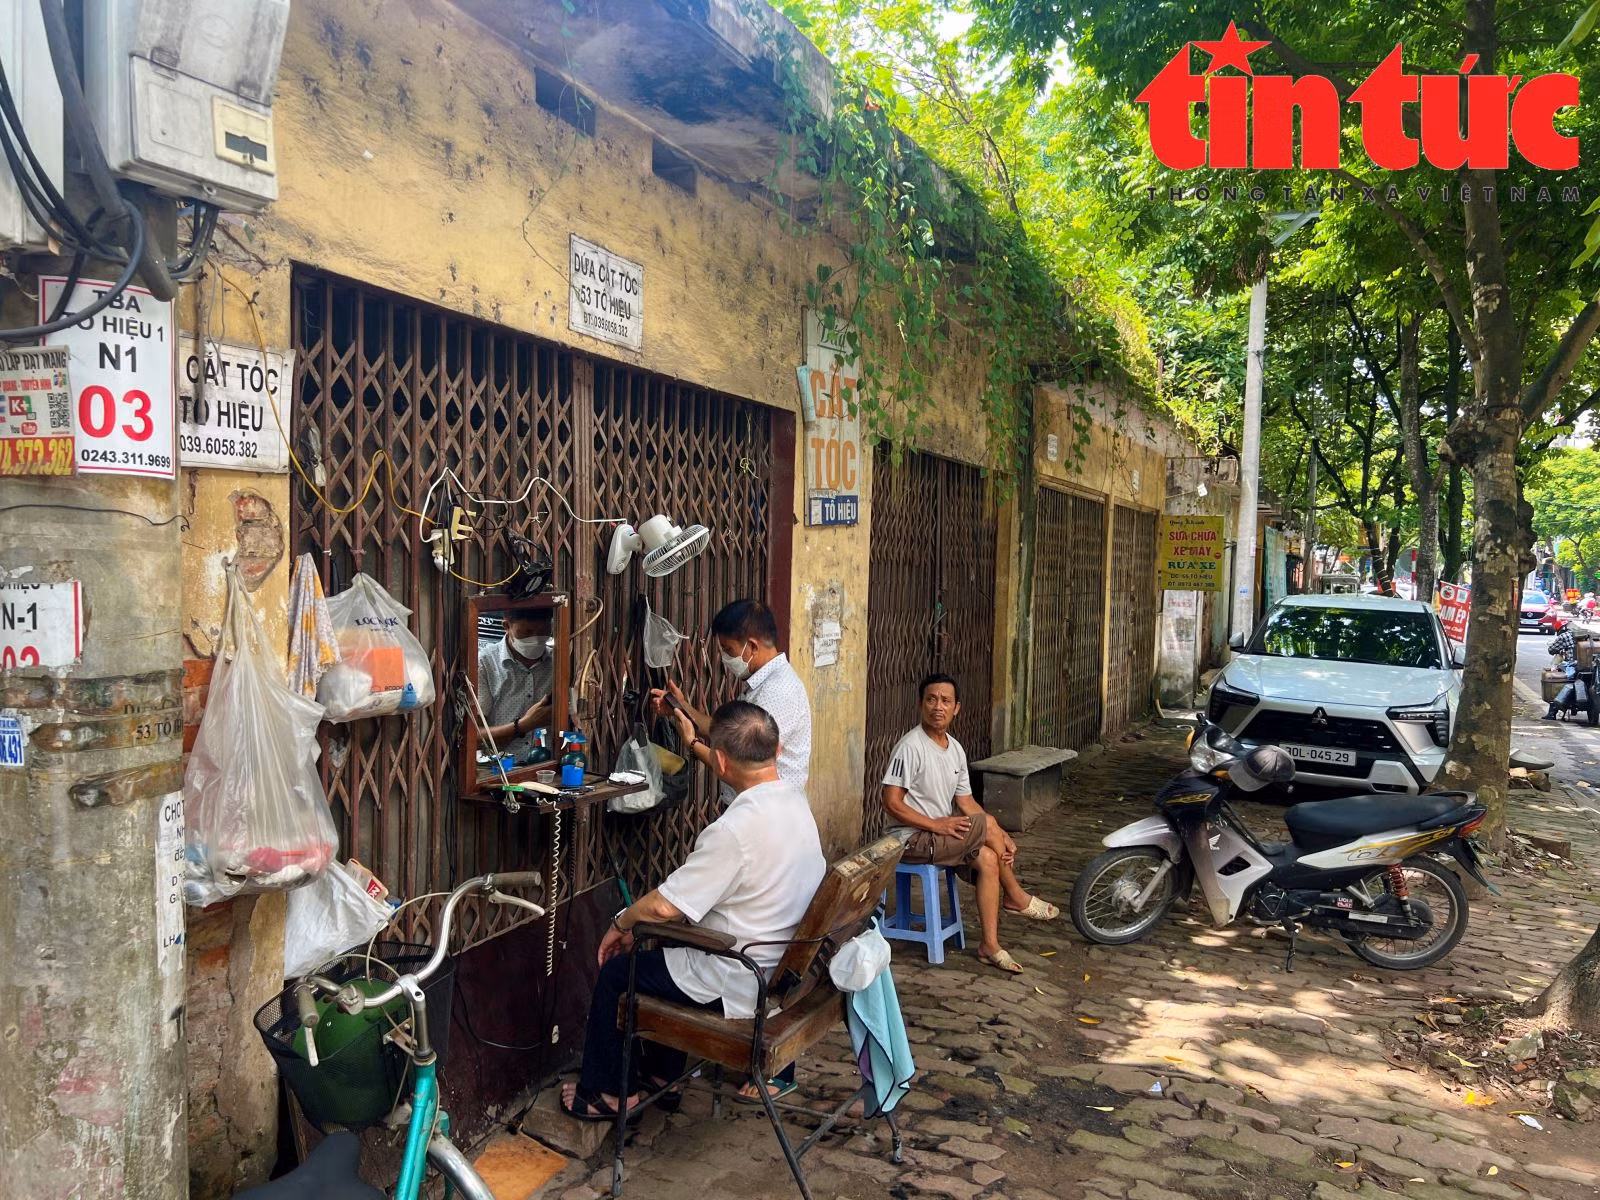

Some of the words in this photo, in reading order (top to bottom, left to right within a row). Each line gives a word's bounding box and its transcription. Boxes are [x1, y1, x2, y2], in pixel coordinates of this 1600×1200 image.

[580, 285, 592, 306] 53
[618, 271, 638, 296] TÓC
[102, 316, 152, 340] HIỆU
[157, 326, 164, 342] 1
[99, 342, 137, 372] N1
[236, 360, 278, 395] TÓC
[78, 385, 154, 442] 03
[217, 400, 263, 437] HIỆU
[81, 448, 171, 469] 0243.311.9699
[179, 434, 258, 459] 039.6058.382
[811, 428, 856, 491] TÓC
[824, 499, 836, 521] TÔ
[837, 499, 857, 524] HIỆU
[2, 602, 37, 630] N-1
